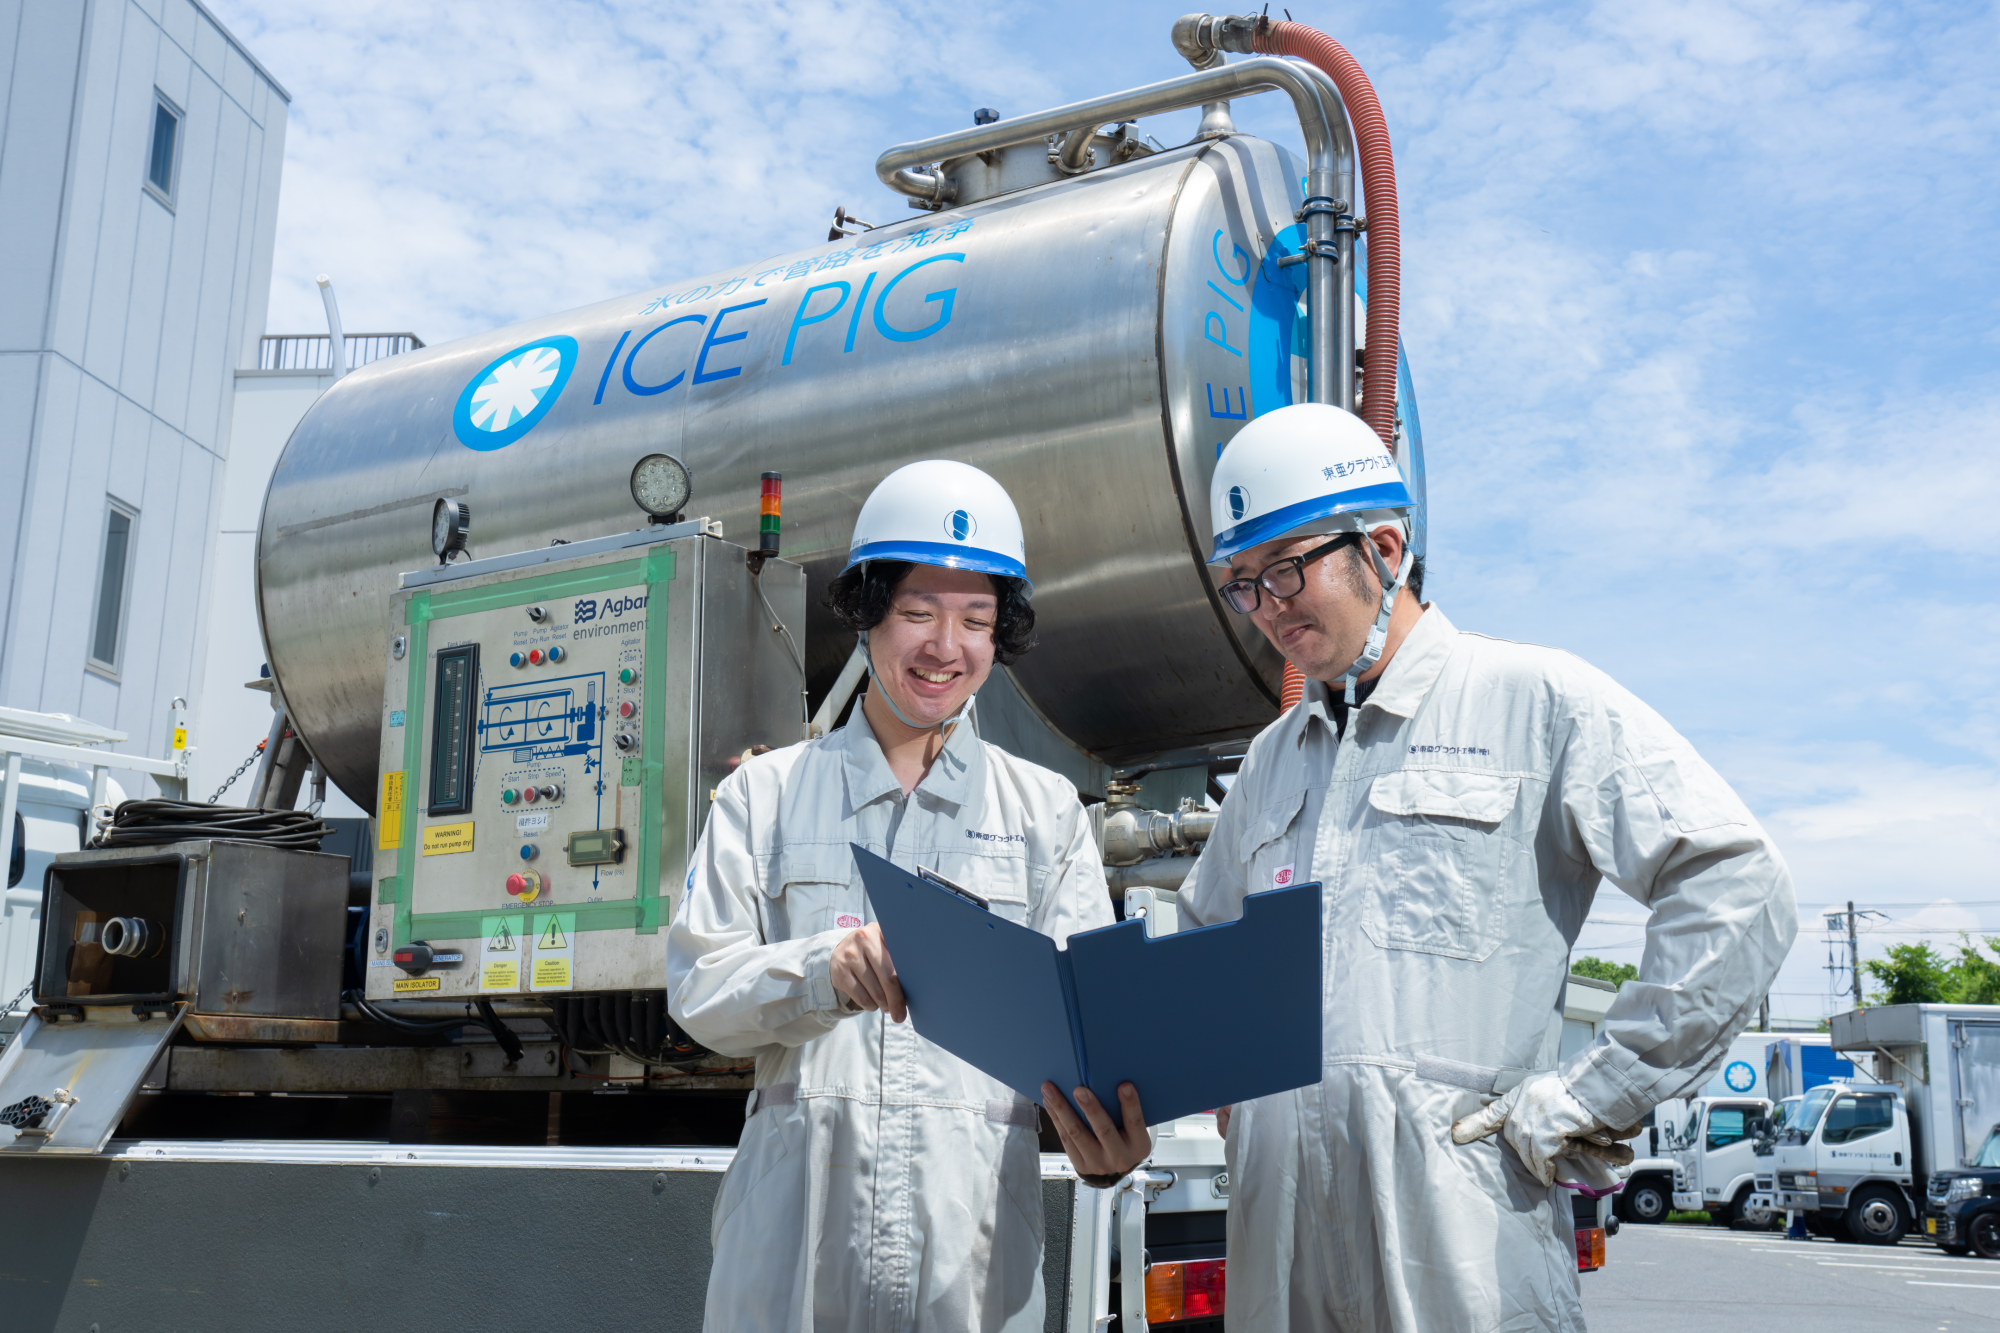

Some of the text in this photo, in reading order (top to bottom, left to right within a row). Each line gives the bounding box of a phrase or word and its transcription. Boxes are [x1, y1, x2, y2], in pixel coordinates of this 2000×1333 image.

[638, 217, 974, 316] 氷の力で管路を洗浄
[1204, 229, 1251, 358] PIG
[593, 252, 966, 406] ICE PIG
[1321, 455, 1396, 481] 東亜グラウト工業
[599, 595, 650, 620] Agbar
[513, 624, 569, 638] Pump Pump Agitator
[573, 619, 650, 640] environment
[447, 641, 458, 649] Tank
[530, 637, 538, 645] Dry
[621, 638, 641, 647] Agitator
[623, 687, 635, 695] Stop
[620, 720, 637, 728] Speed
[528, 773, 540, 781] Stop
[545, 770, 562, 778] Speed
[416, 807, 429, 815] Emp
[435, 829, 462, 838] WARNING!
[502, 901, 537, 909] EMERGENCY
[396, 980, 437, 989] MAIN ISOLATOR
